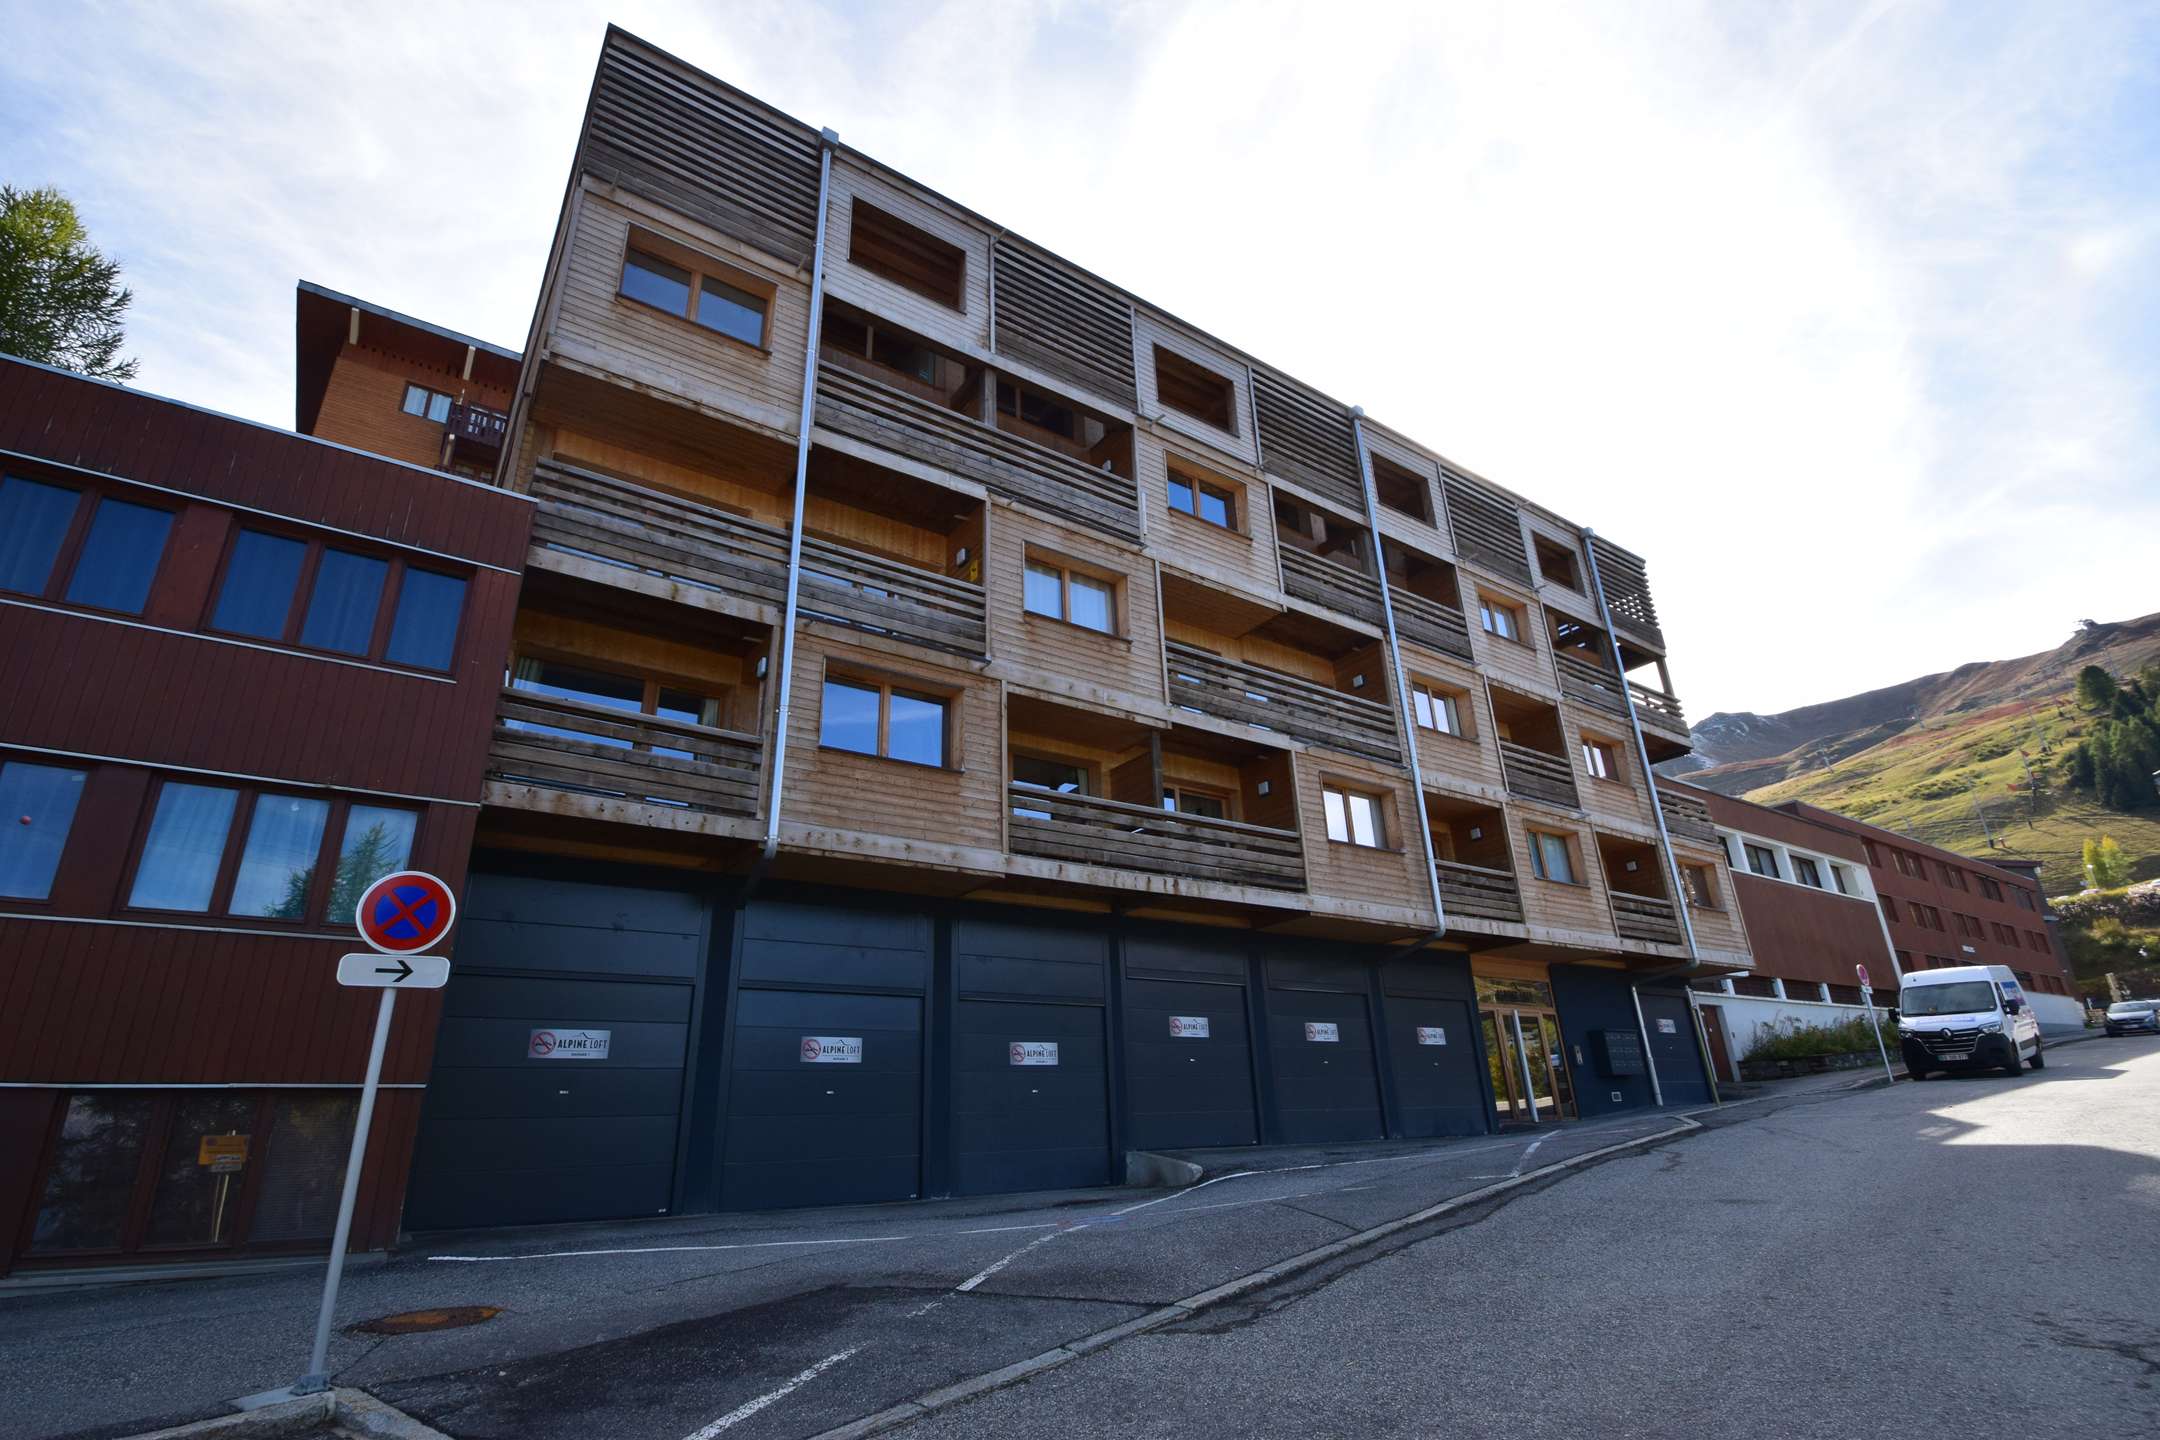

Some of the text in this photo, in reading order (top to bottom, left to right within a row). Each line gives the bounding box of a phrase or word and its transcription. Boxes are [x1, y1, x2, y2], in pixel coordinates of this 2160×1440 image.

[557, 1039, 609, 1049] ALPINE LOFT
[822, 1045, 861, 1054] ALPINE LOFT
[1026, 1049, 1045, 1057] ALPINE
